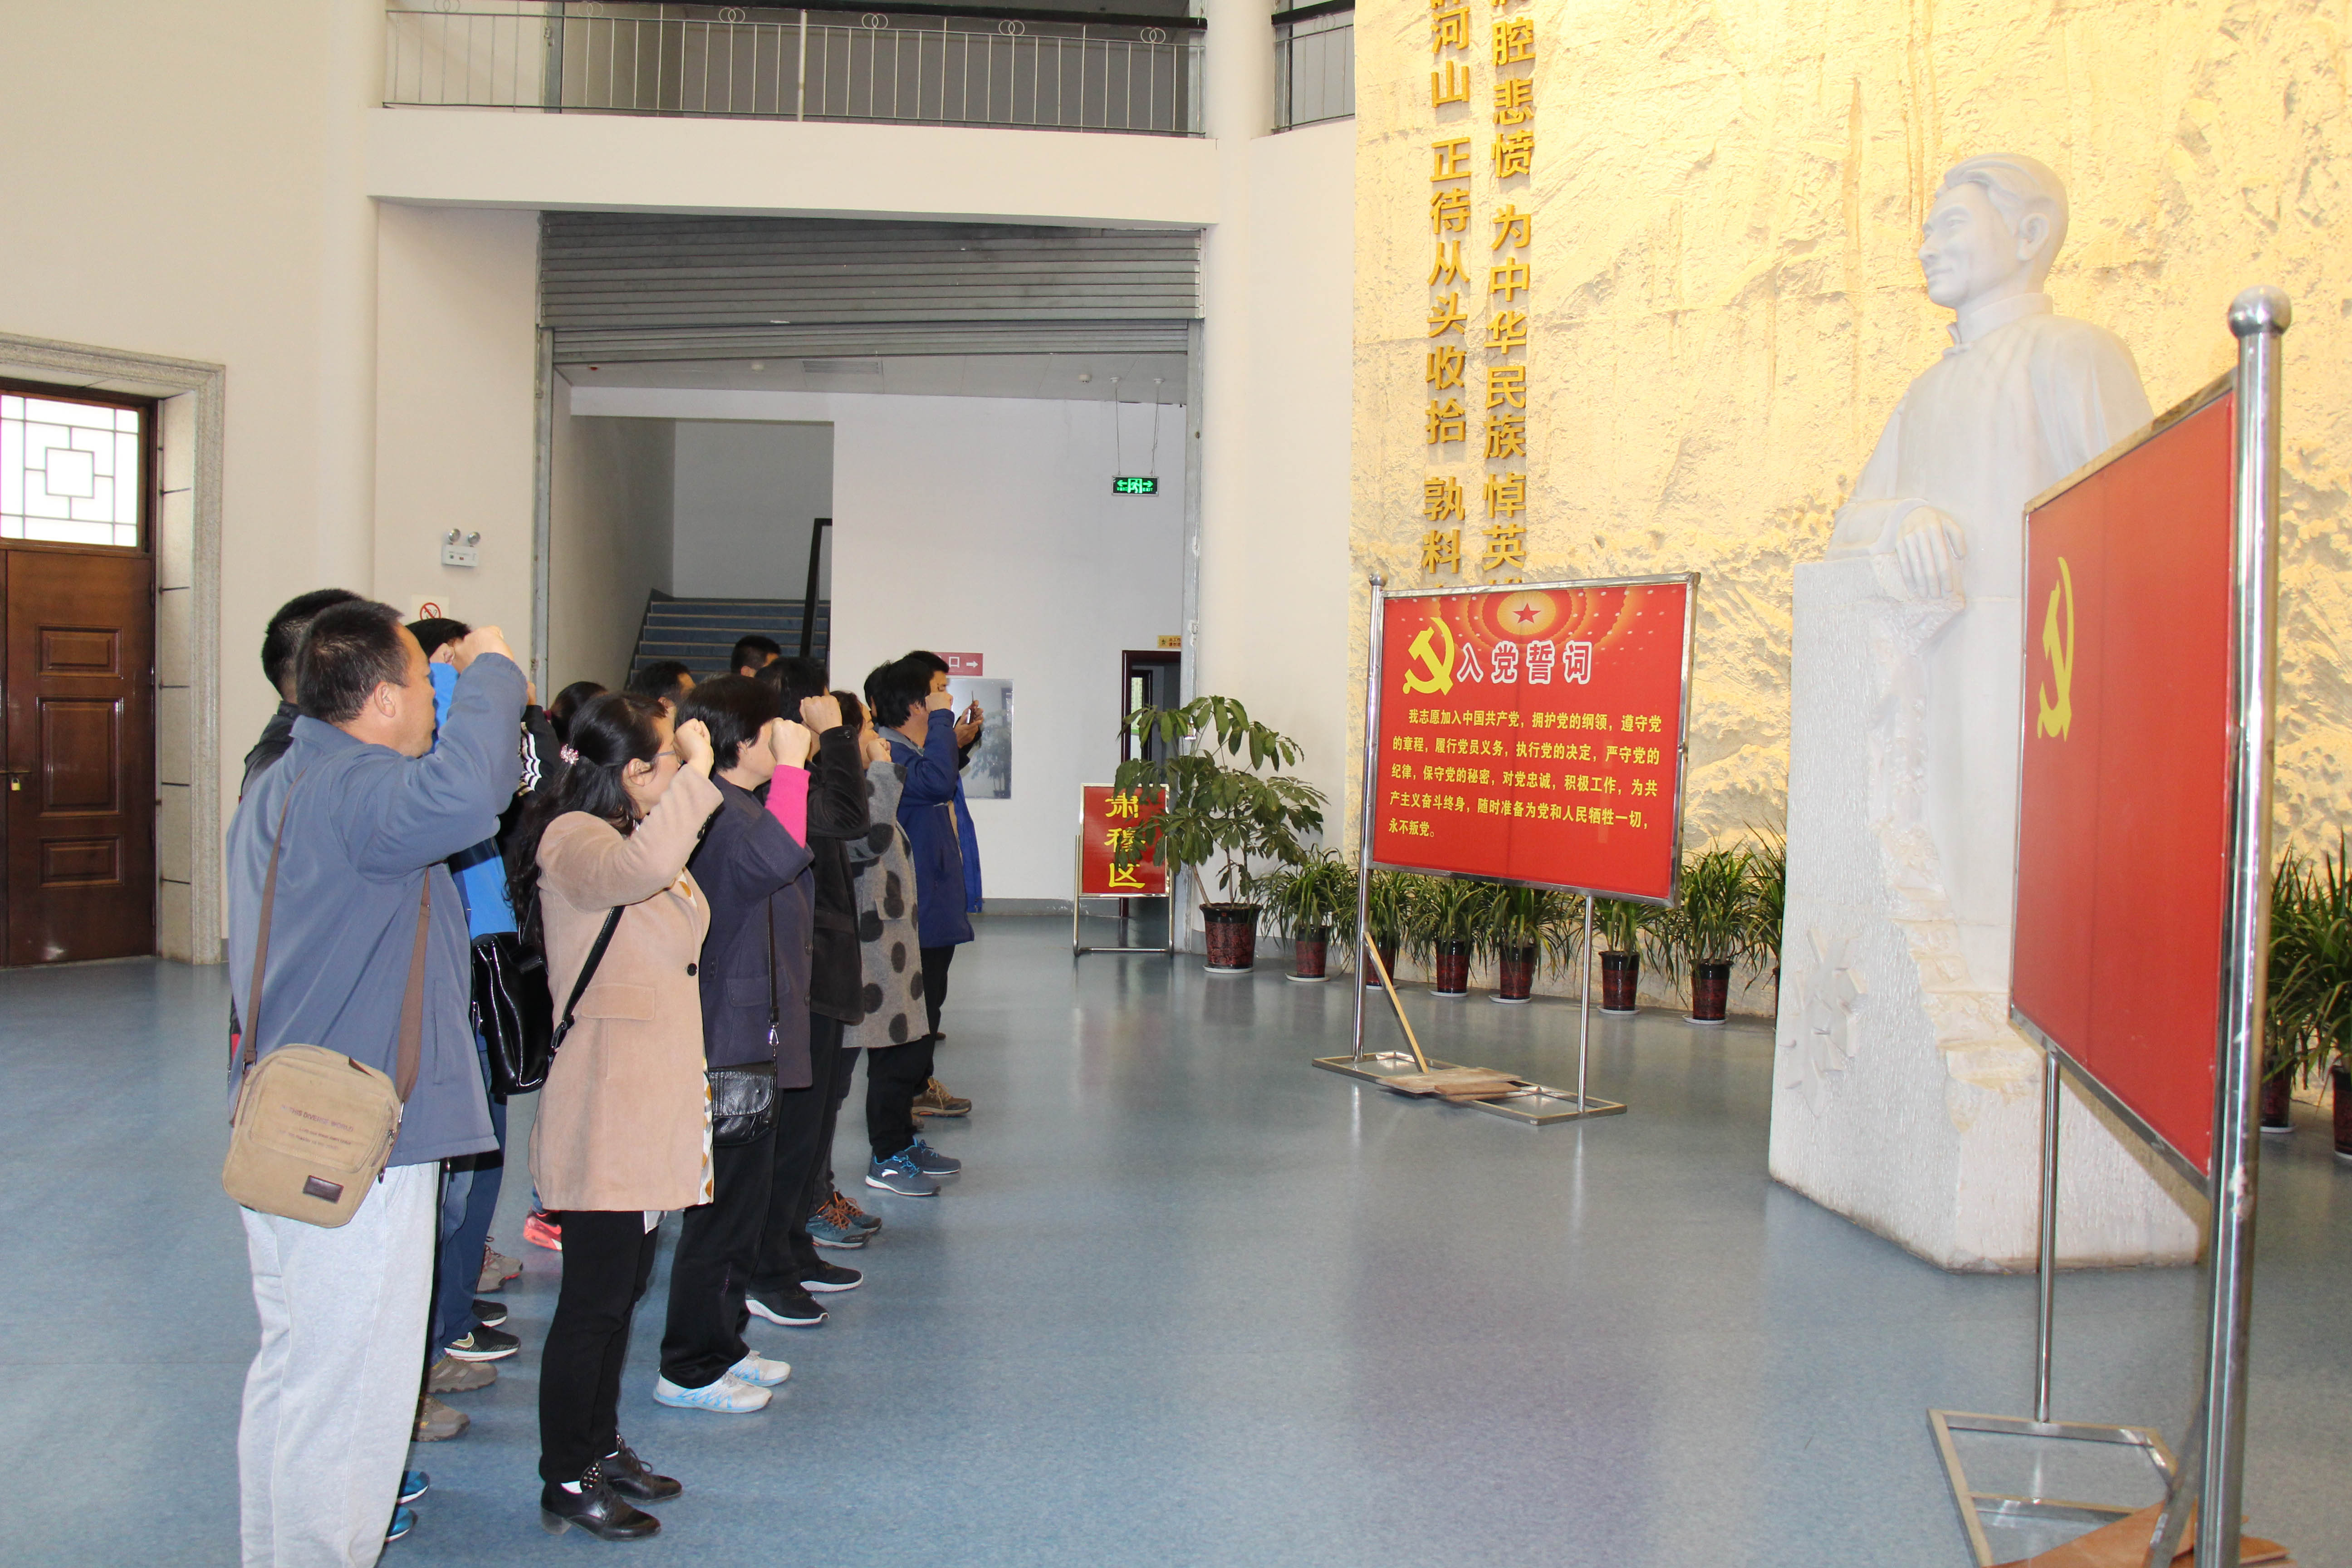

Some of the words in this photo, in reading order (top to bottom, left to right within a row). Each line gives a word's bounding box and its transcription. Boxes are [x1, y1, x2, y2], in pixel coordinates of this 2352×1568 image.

[1425, 137, 1471, 444] 正待从头收拾
[1482, 204, 1531, 459] 为中华民族
[1456, 640, 1592, 684] 入党誓词
[1408, 708, 1661, 732] 我志愿加入中国共产党，拥护党的纲领，遵守党
[1393, 736, 1659, 764] 的章程，履行党员义务，执行党的决定，严守党的
[1391, 763, 1657, 797] 纪律，保守党的秘密，对党忠诚，积极工作，为共
[1390, 790, 1648, 829] 产主义奋斗终身，随时准备为党和人民牺牲一切，
[1388, 818, 1434, 838] 永不叛党。
